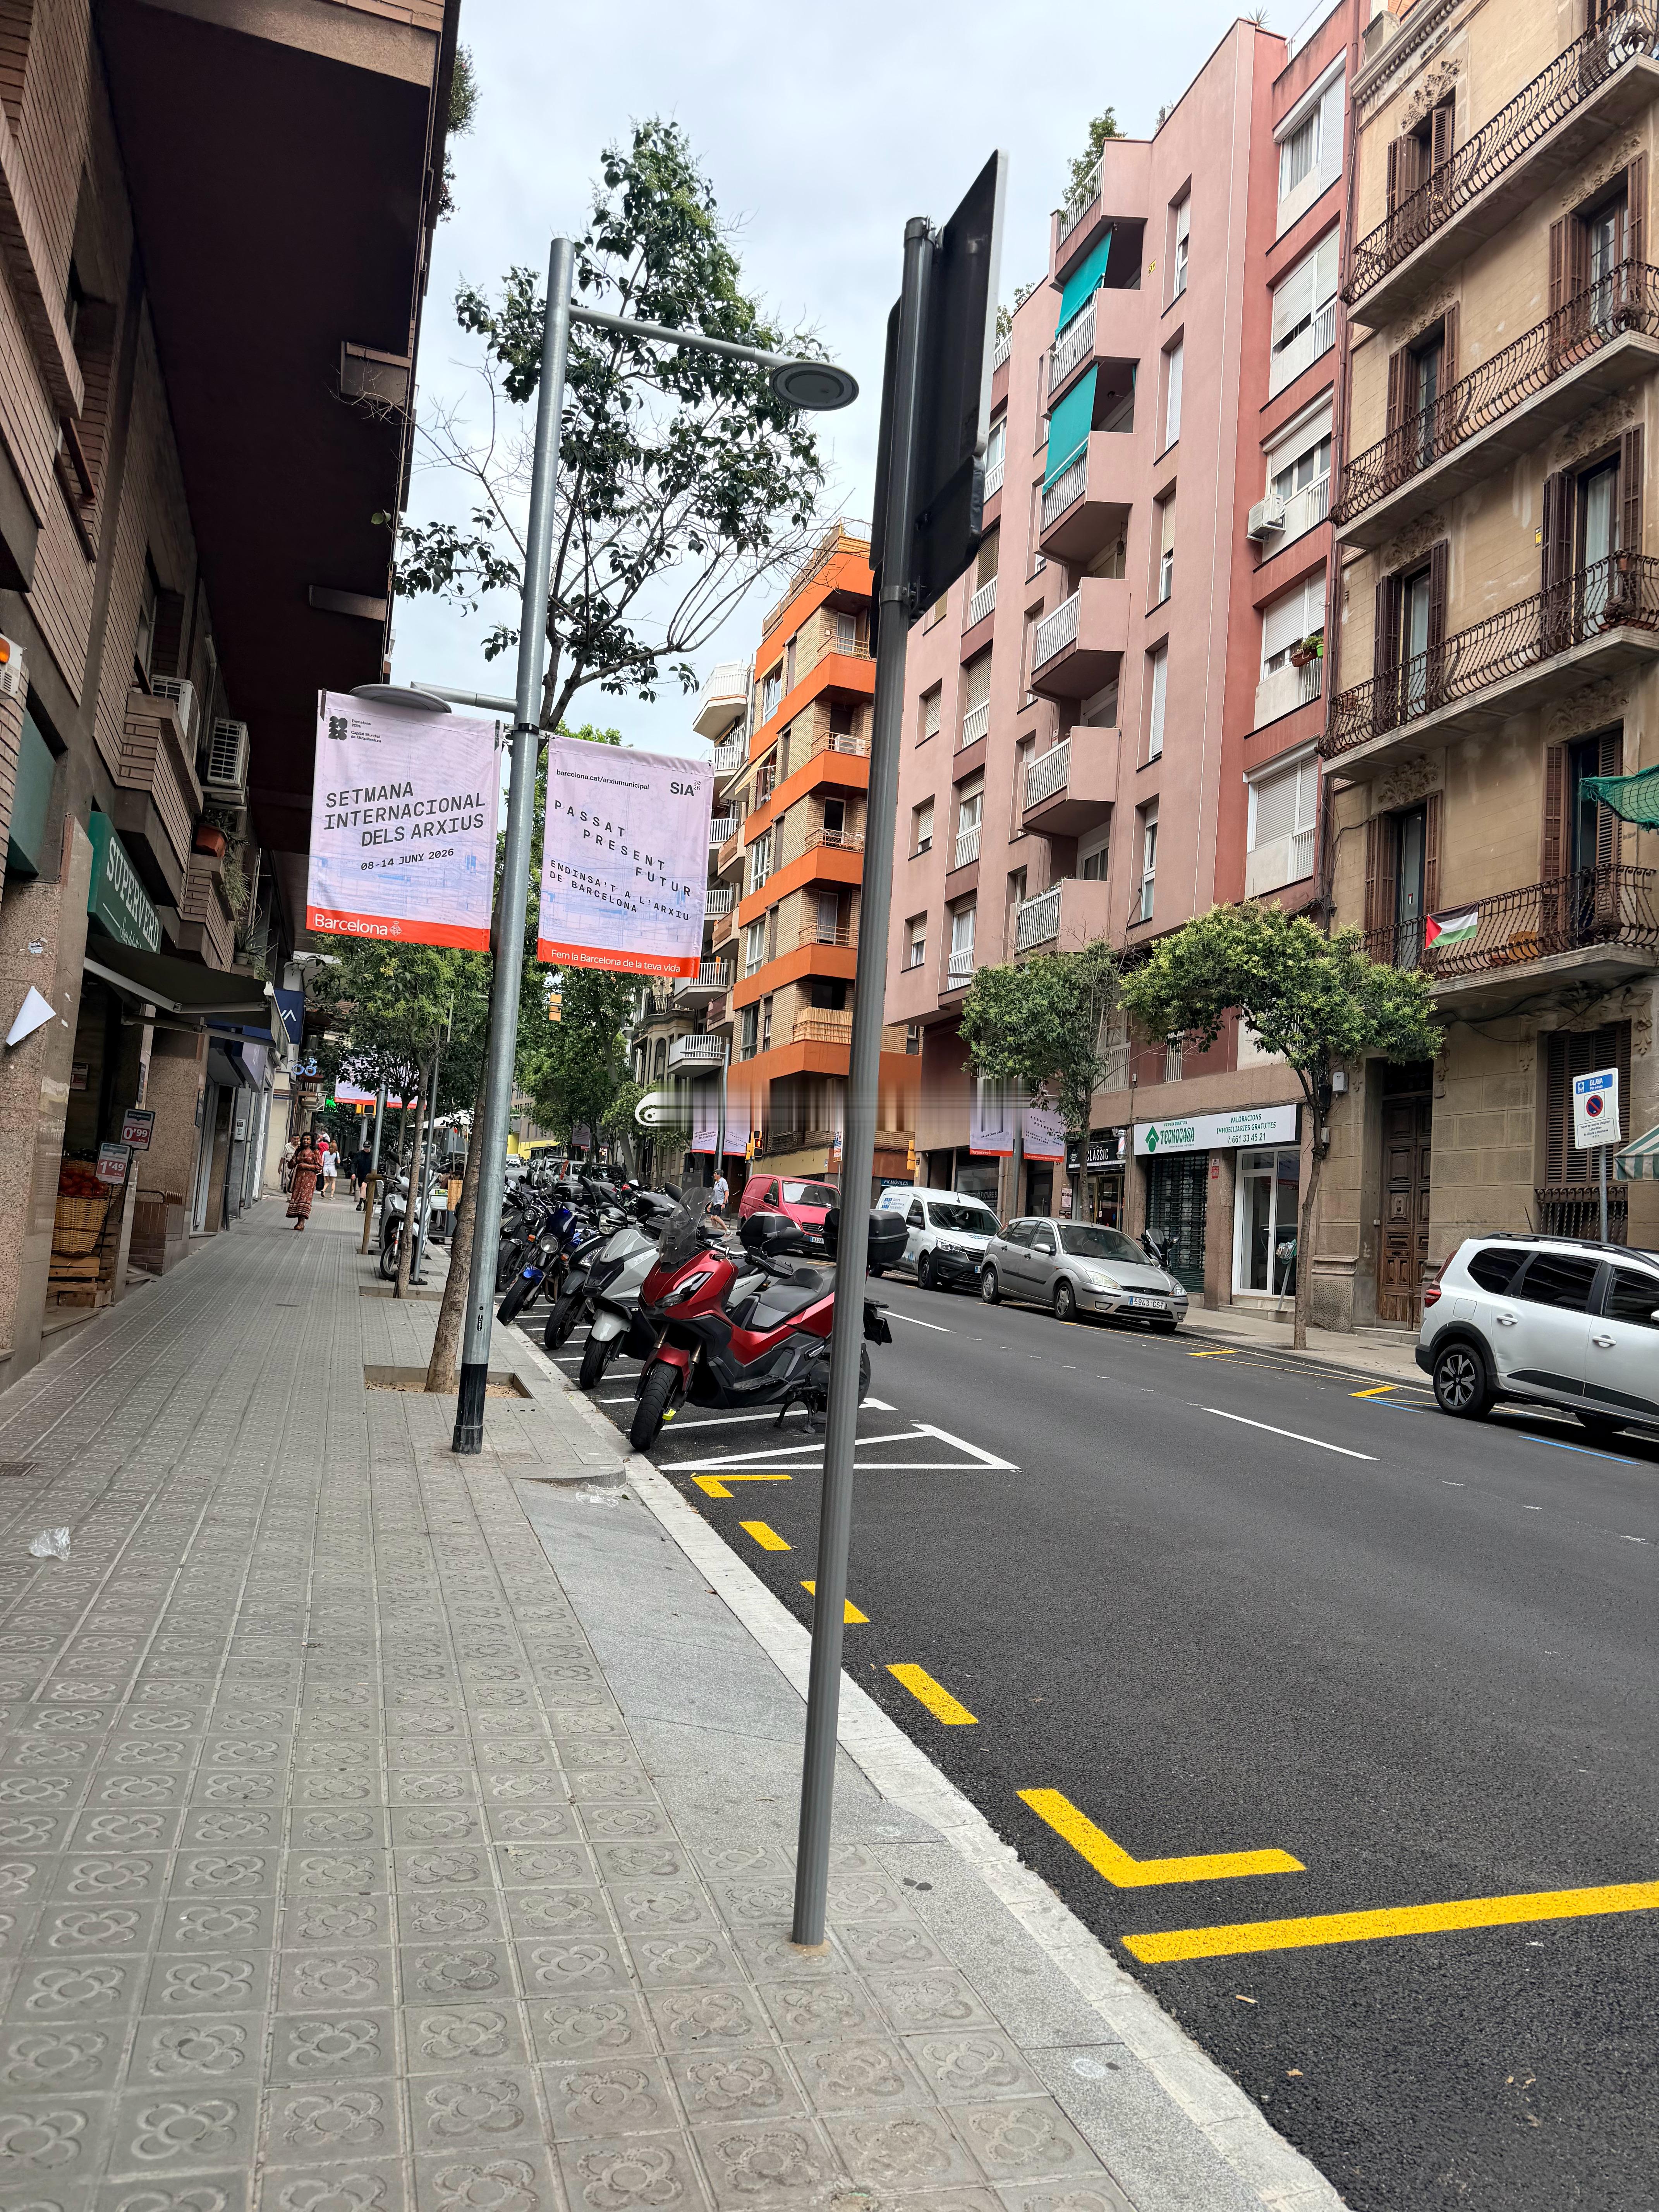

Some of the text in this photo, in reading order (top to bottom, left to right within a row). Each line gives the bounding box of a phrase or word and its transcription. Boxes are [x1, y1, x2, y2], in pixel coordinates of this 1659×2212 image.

[556, 769, 649, 790] barcelona.cat/arxiumunicipal
[670, 781, 695, 797] SIA
[326, 781, 414, 808] SETMANA
[324, 792, 485, 830] INTERNACIONAL
[555, 800, 625, 837] PASSAT
[361, 813, 484, 847] DELS ARXIUS
[361, 848, 454, 871] 08-14 JUNY 2026
[583, 829, 665, 870] PRESENT
[550, 871, 637, 913] DE BARCELONA
[551, 859, 689, 921] ENDINSA'T A L'ARXIU
[635, 866, 690, 896] FUTUR
[106, 836, 159, 952] SUPERVERD
[315, 913, 388, 936] Barcelona
[551, 949, 681, 972] Fem la Barcelona de la teva vida
[1230, 1114, 1262, 1123] VALORACIONS
[1160, 1127, 1195, 1145] TECNOCASA
[1232, 1132, 1266, 1143] 661 33 45 21
[1134, 1298, 1149, 1306] 5943
